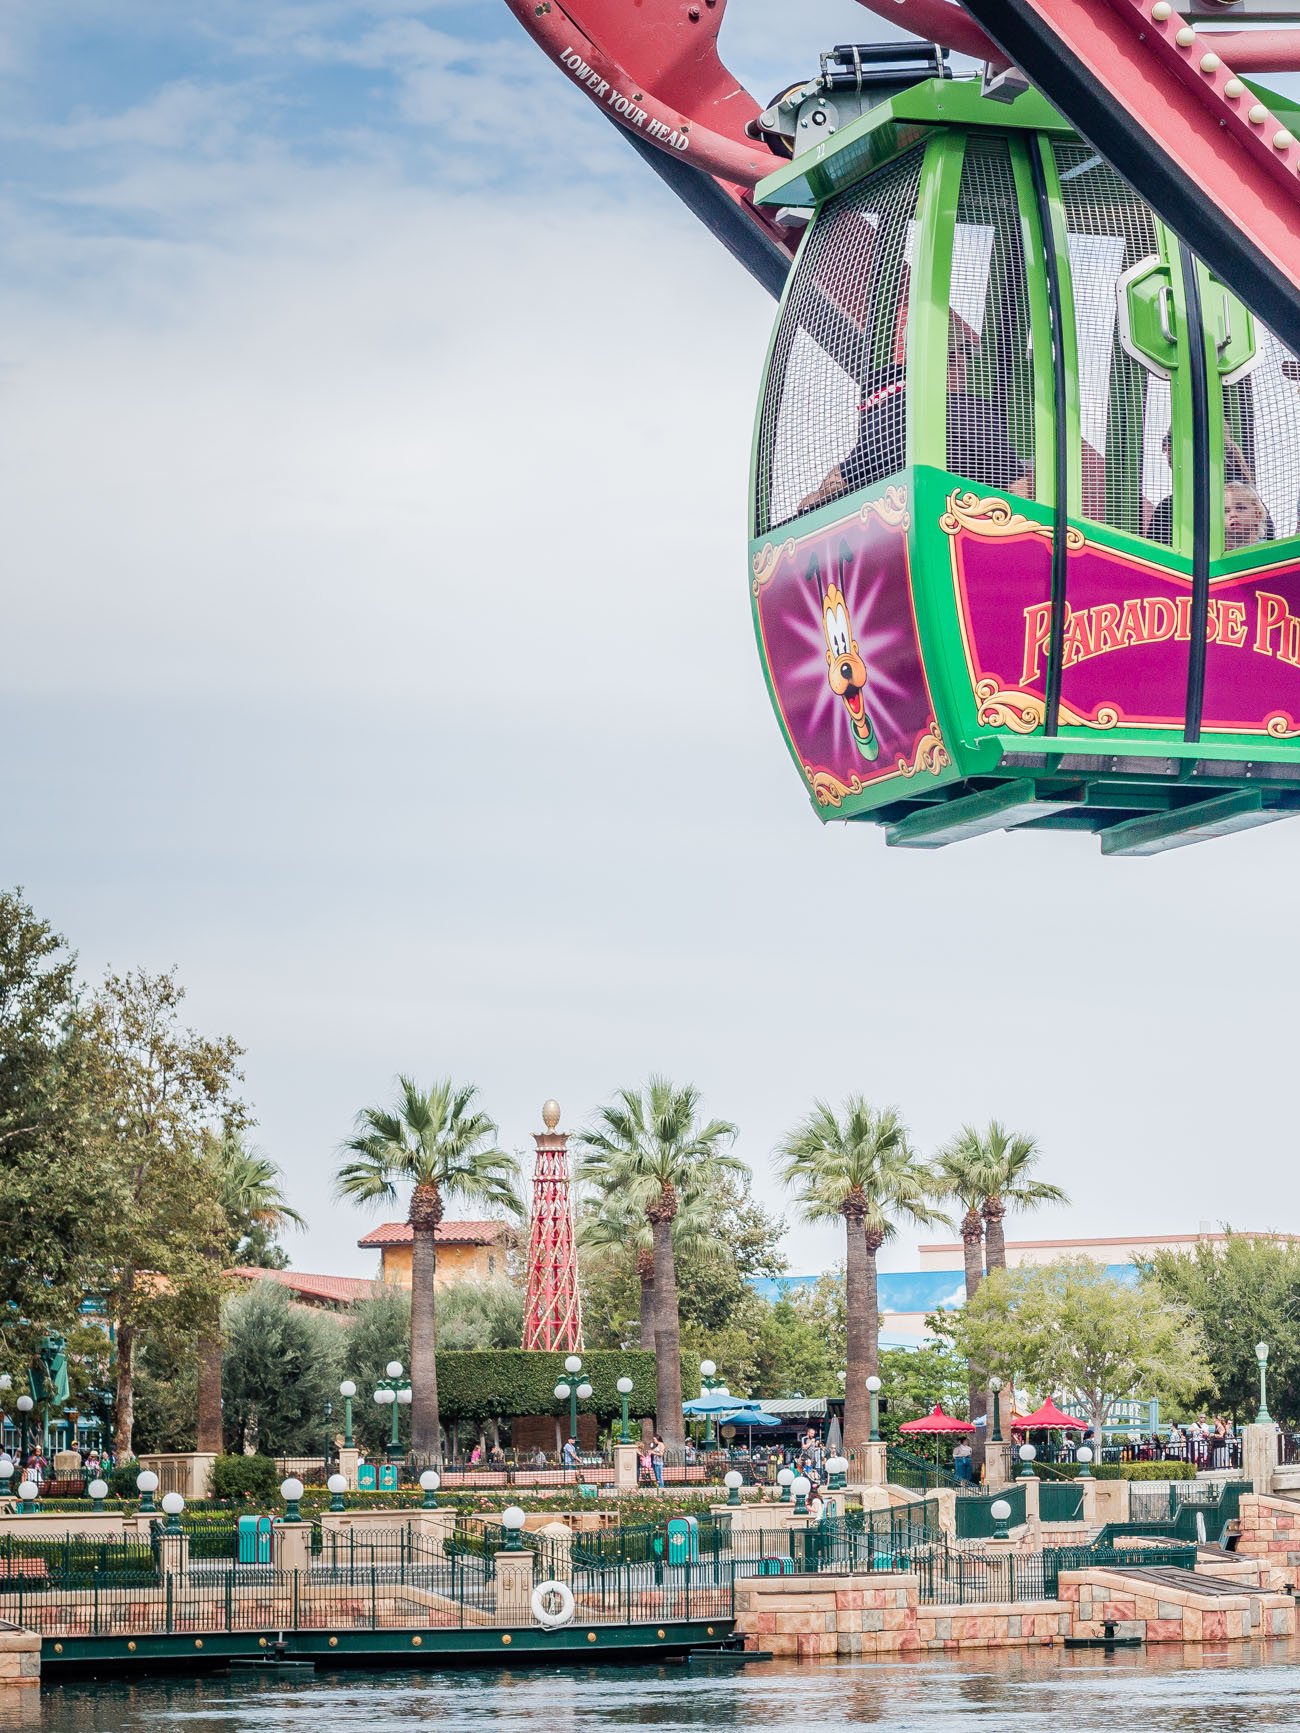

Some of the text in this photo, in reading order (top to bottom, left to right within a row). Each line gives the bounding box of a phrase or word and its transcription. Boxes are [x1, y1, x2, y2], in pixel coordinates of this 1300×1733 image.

[559, 46, 689, 151] LOWER YOUR HEAD
[816, 143, 825, 160] 22
